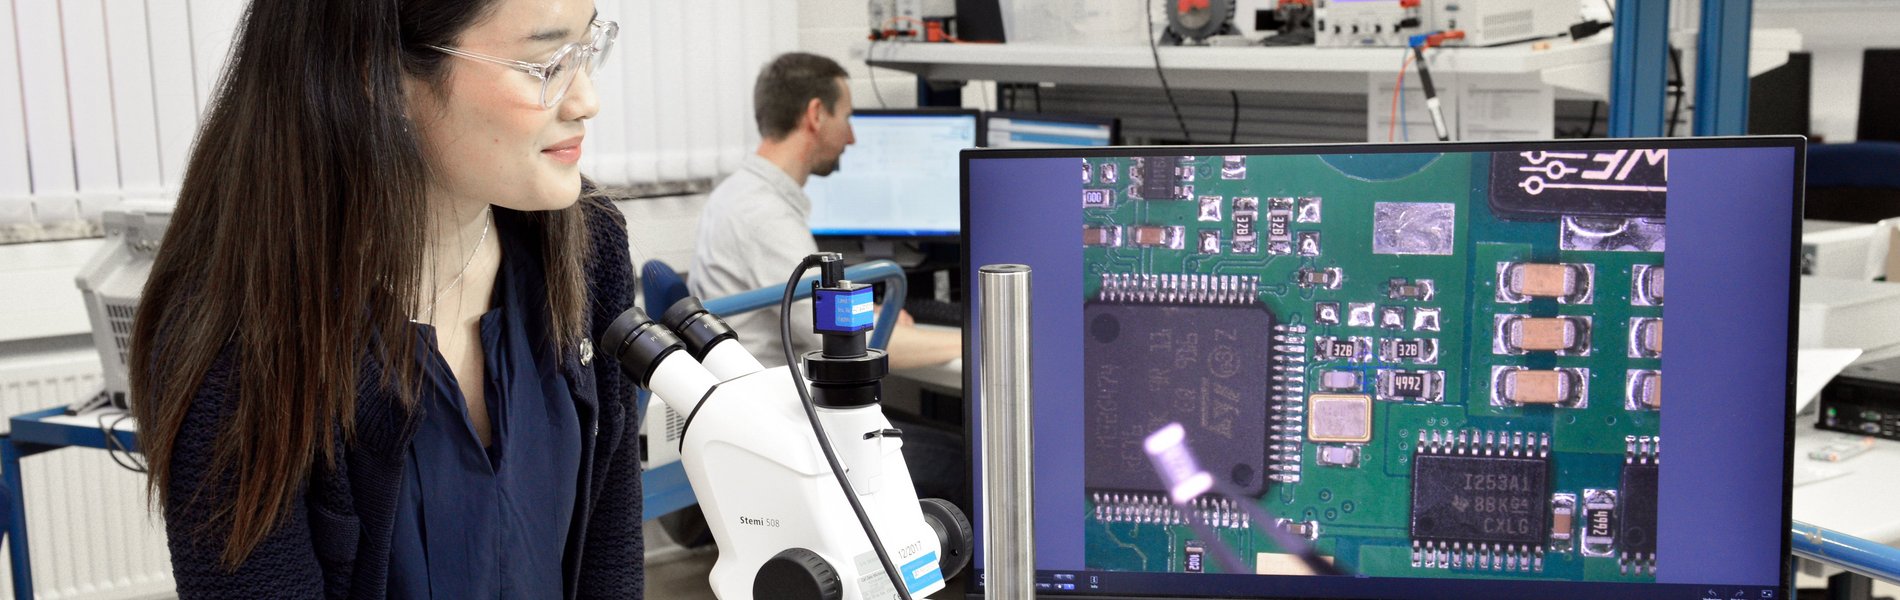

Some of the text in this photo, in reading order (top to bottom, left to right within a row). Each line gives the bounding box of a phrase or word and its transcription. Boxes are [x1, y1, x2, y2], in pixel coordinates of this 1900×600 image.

[1236, 216, 1249, 235] 32B
[1272, 216, 1285, 235] 32B
[1334, 344, 1353, 357] 32B
[1399, 344, 1418, 356] 32B
[1395, 376, 1421, 390] 4992
[740, 516, 780, 528] Stemi 508
[1593, 511, 1608, 535] 4992
[898, 540, 921, 559] 12/2017
[1188, 554, 1200, 570] 1002
